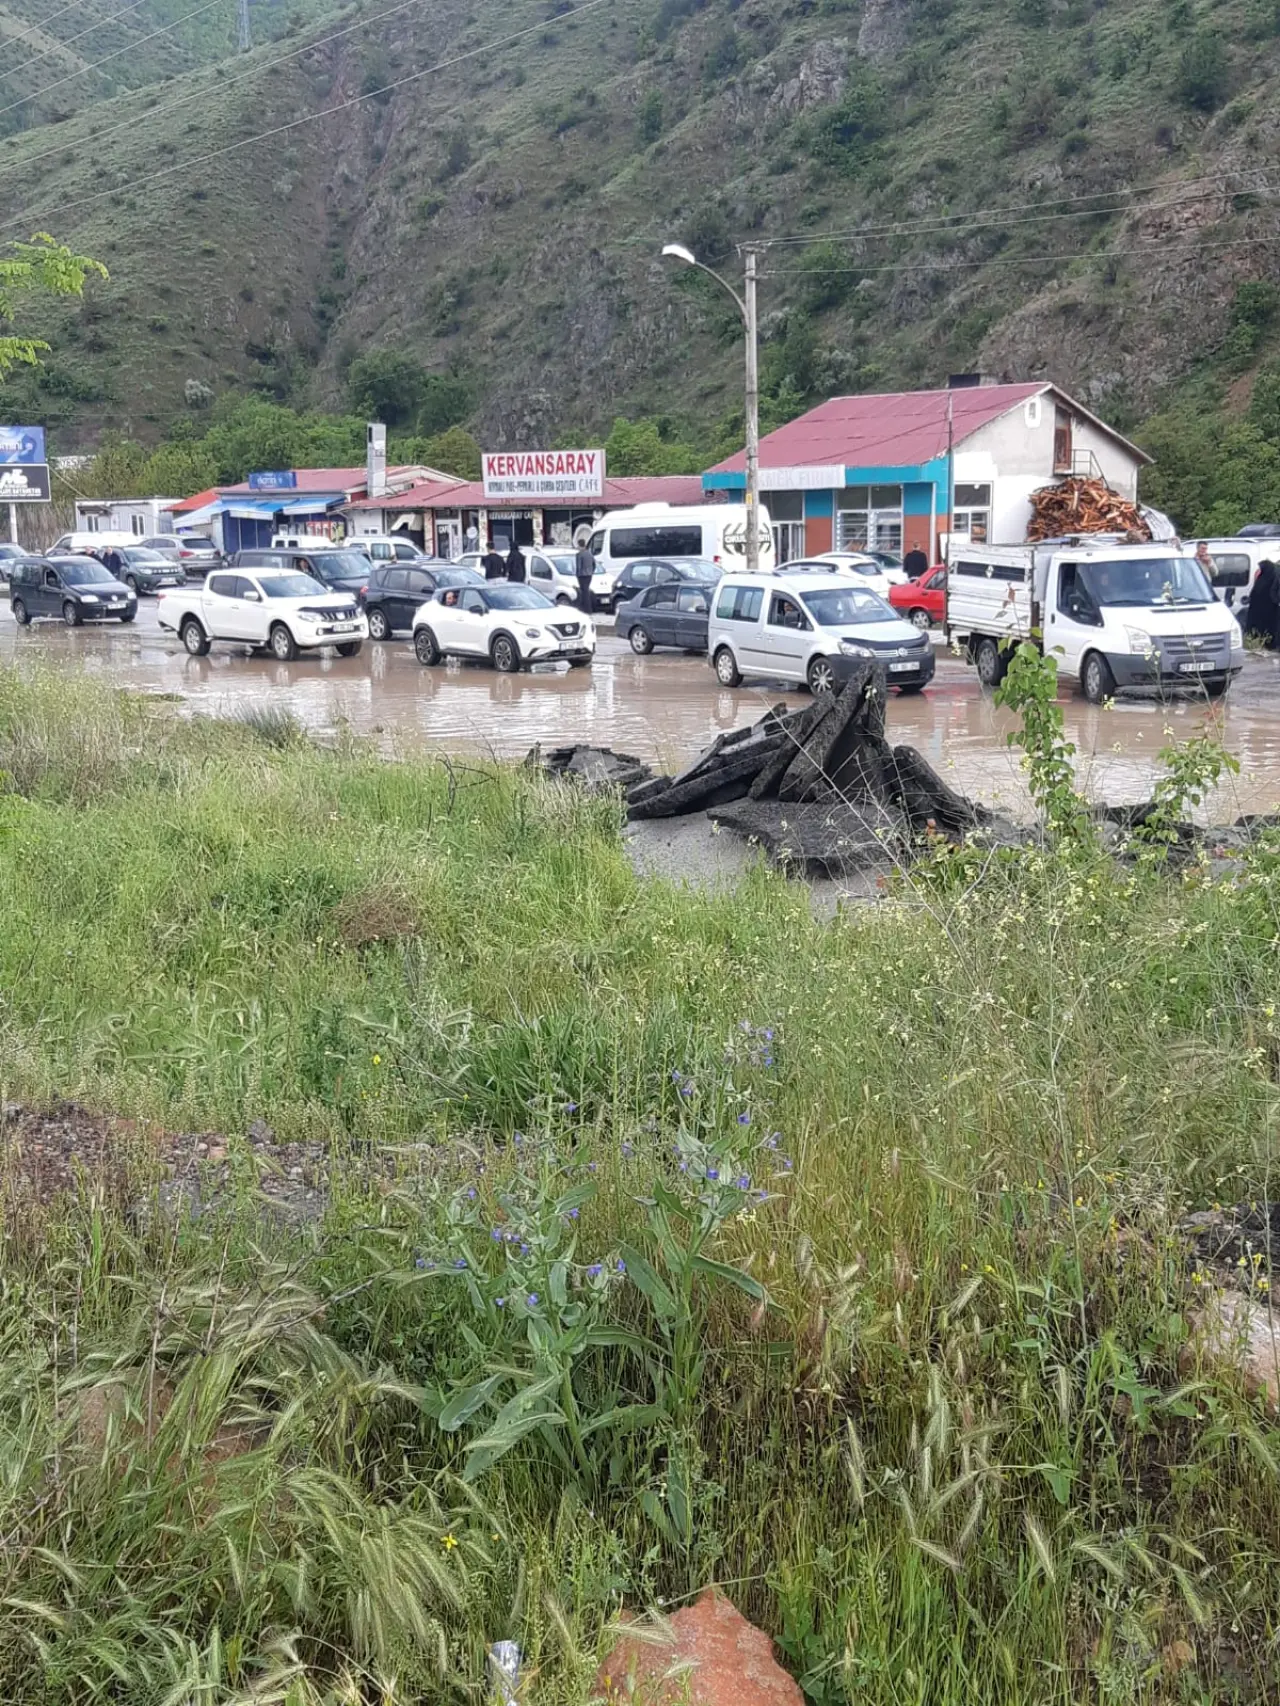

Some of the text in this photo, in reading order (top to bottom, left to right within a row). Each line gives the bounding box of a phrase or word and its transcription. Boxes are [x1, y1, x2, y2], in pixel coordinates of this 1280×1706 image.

[487, 453, 595, 476] KERVANSARAY
[579, 478, 598, 492] CAFE
[757, 472, 794, 487] KMEK
